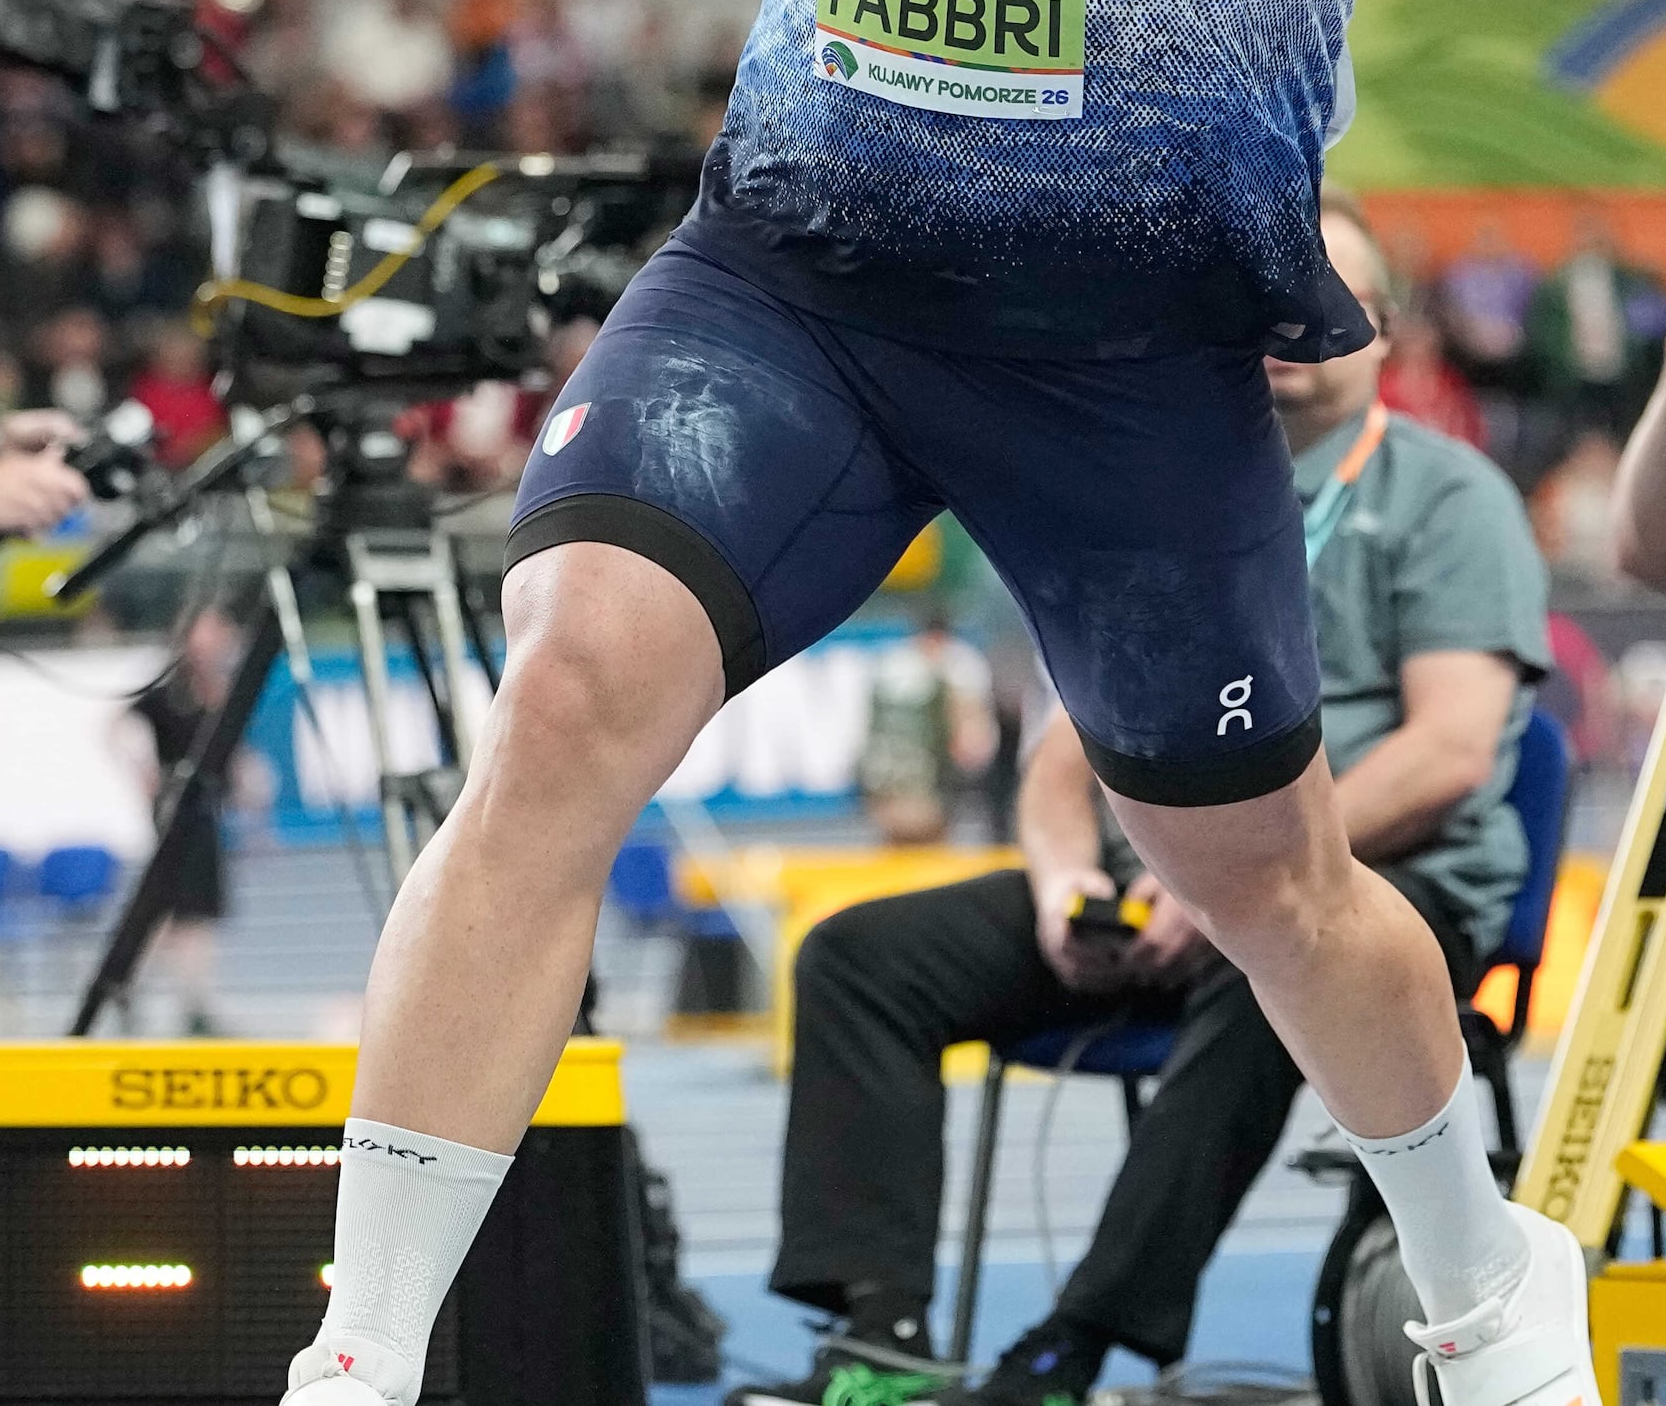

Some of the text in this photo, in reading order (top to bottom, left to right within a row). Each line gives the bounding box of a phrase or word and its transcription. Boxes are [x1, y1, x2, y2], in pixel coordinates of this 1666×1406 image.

[868, 63, 1069, 105] KUJAWY POMORZE 26
[111, 1067, 329, 1111] SEIKO
[1540, 1055, 1616, 1224] SEIKO
